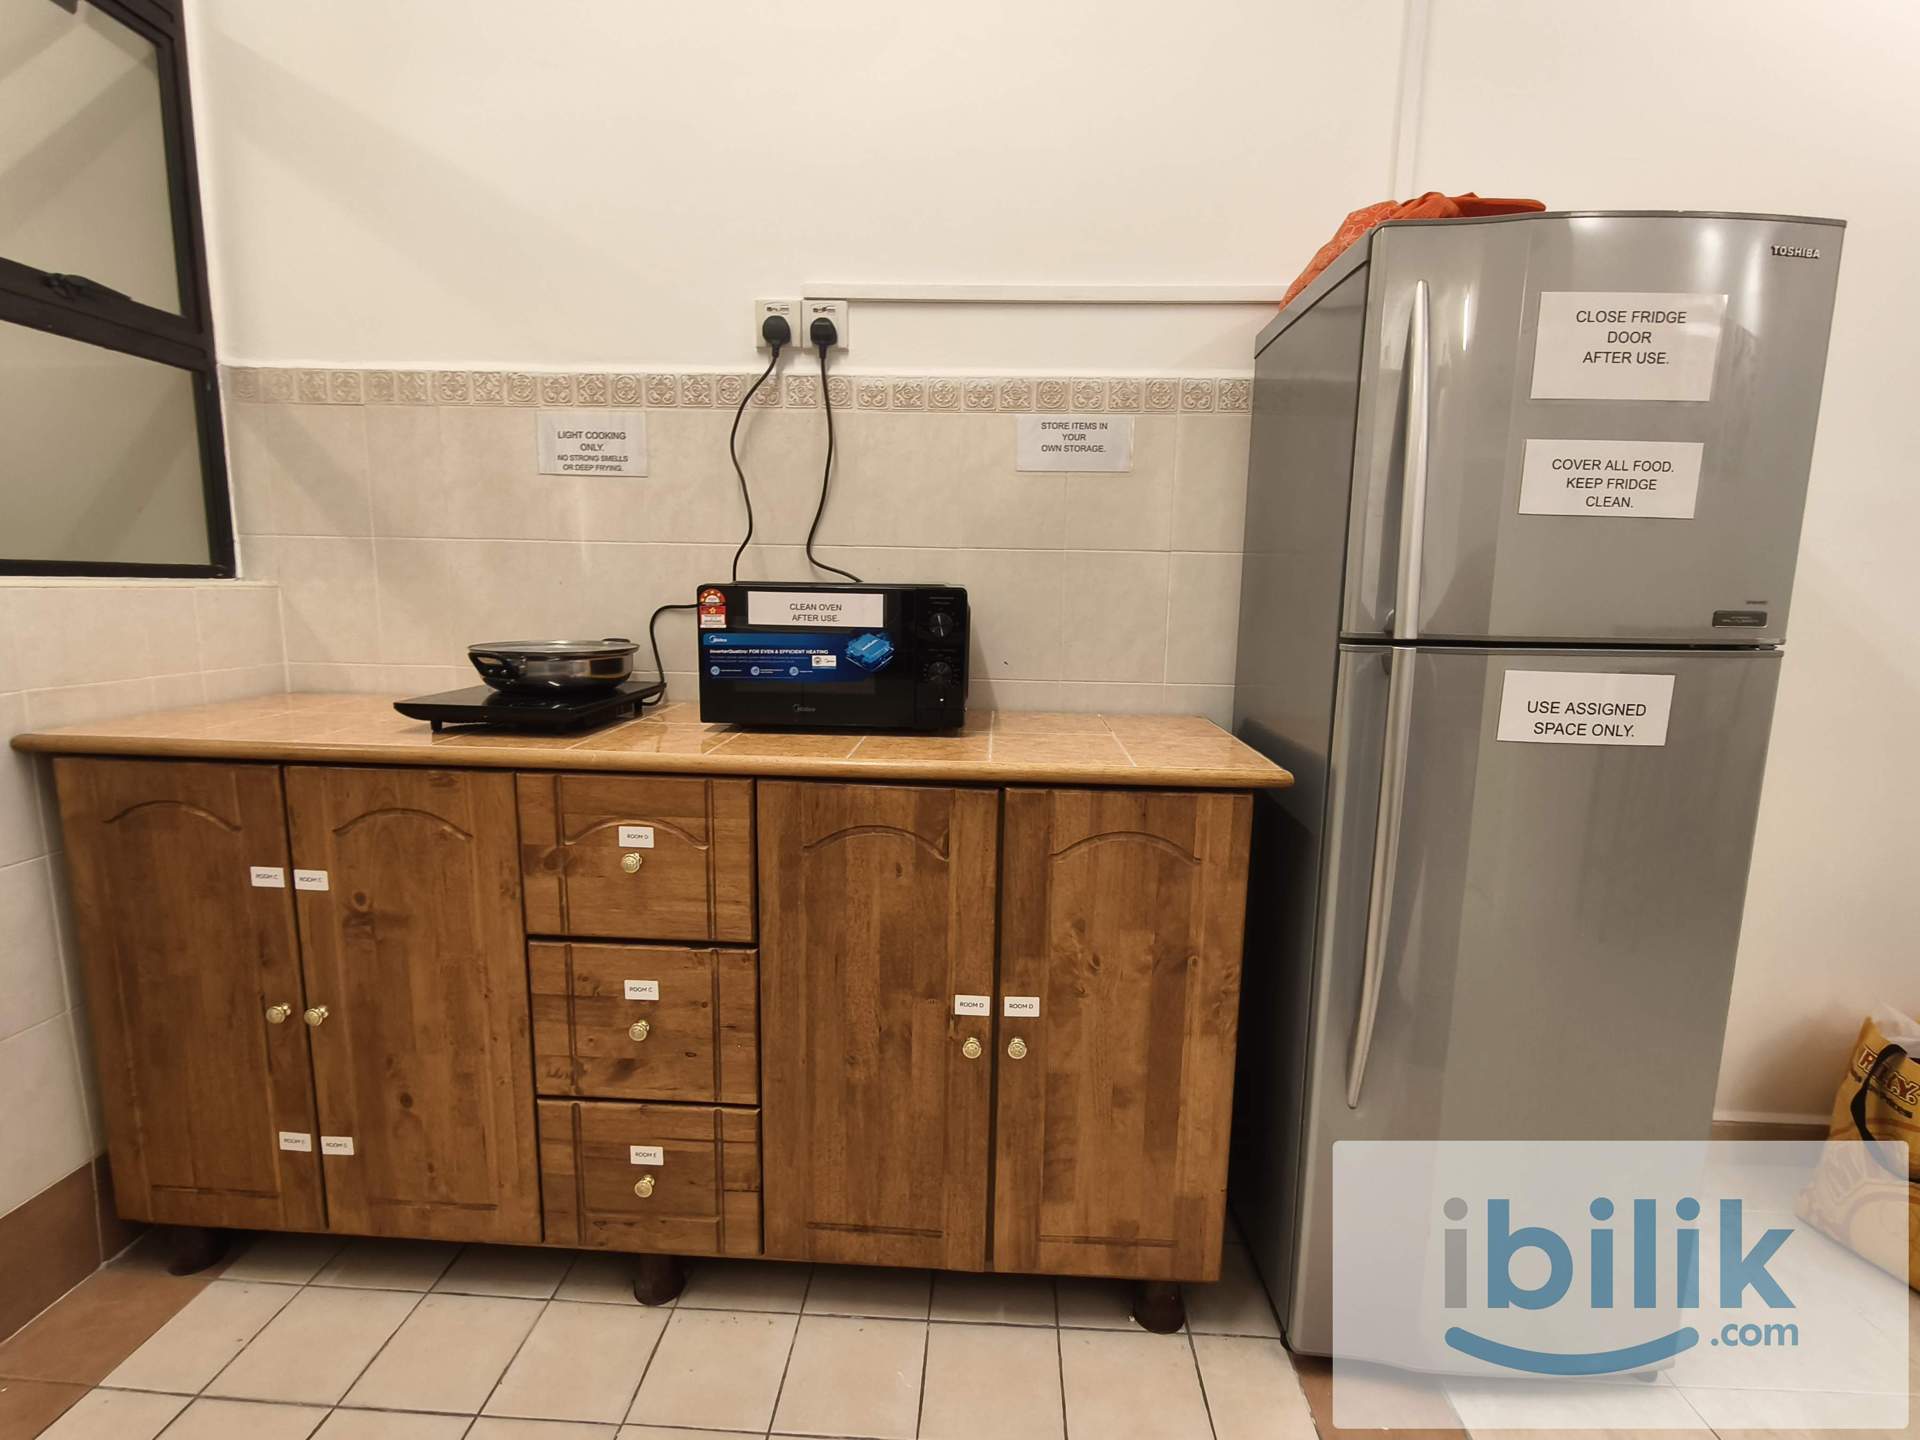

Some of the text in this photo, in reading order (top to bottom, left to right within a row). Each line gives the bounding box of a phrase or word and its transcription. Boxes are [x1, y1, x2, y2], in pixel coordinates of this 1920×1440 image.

[1771, 245, 1820, 259] TOSHIBA
[1576, 310, 1687, 325] CLOSE FRIDGE
[1607, 330, 1652, 344] DOOR
[1583, 351, 1670, 365] AFTER USE.
[1041, 422, 1108, 430] STORE ITEMS IN
[557, 431, 627, 440] LIGHT COOKING
[1062, 433, 1087, 441] YOUR
[580, 443, 605, 452] ONLY.
[1041, 444, 1106, 453] OWN STORAGE.
[557, 454, 628, 463] NO STRONG SMELLS
[1552, 458, 1675, 473] COVER ALL FOOD.
[1566, 477, 1658, 491] KEEP FRIDGE
[1585, 496, 1634, 508] CLEAN.
[790, 603, 842, 611] CLEAN OVEN
[791, 614, 819, 622] AFTER
[1527, 700, 1647, 717] USE ASSIGNED
[1533, 722, 1634, 737] SPACE ONLY.
